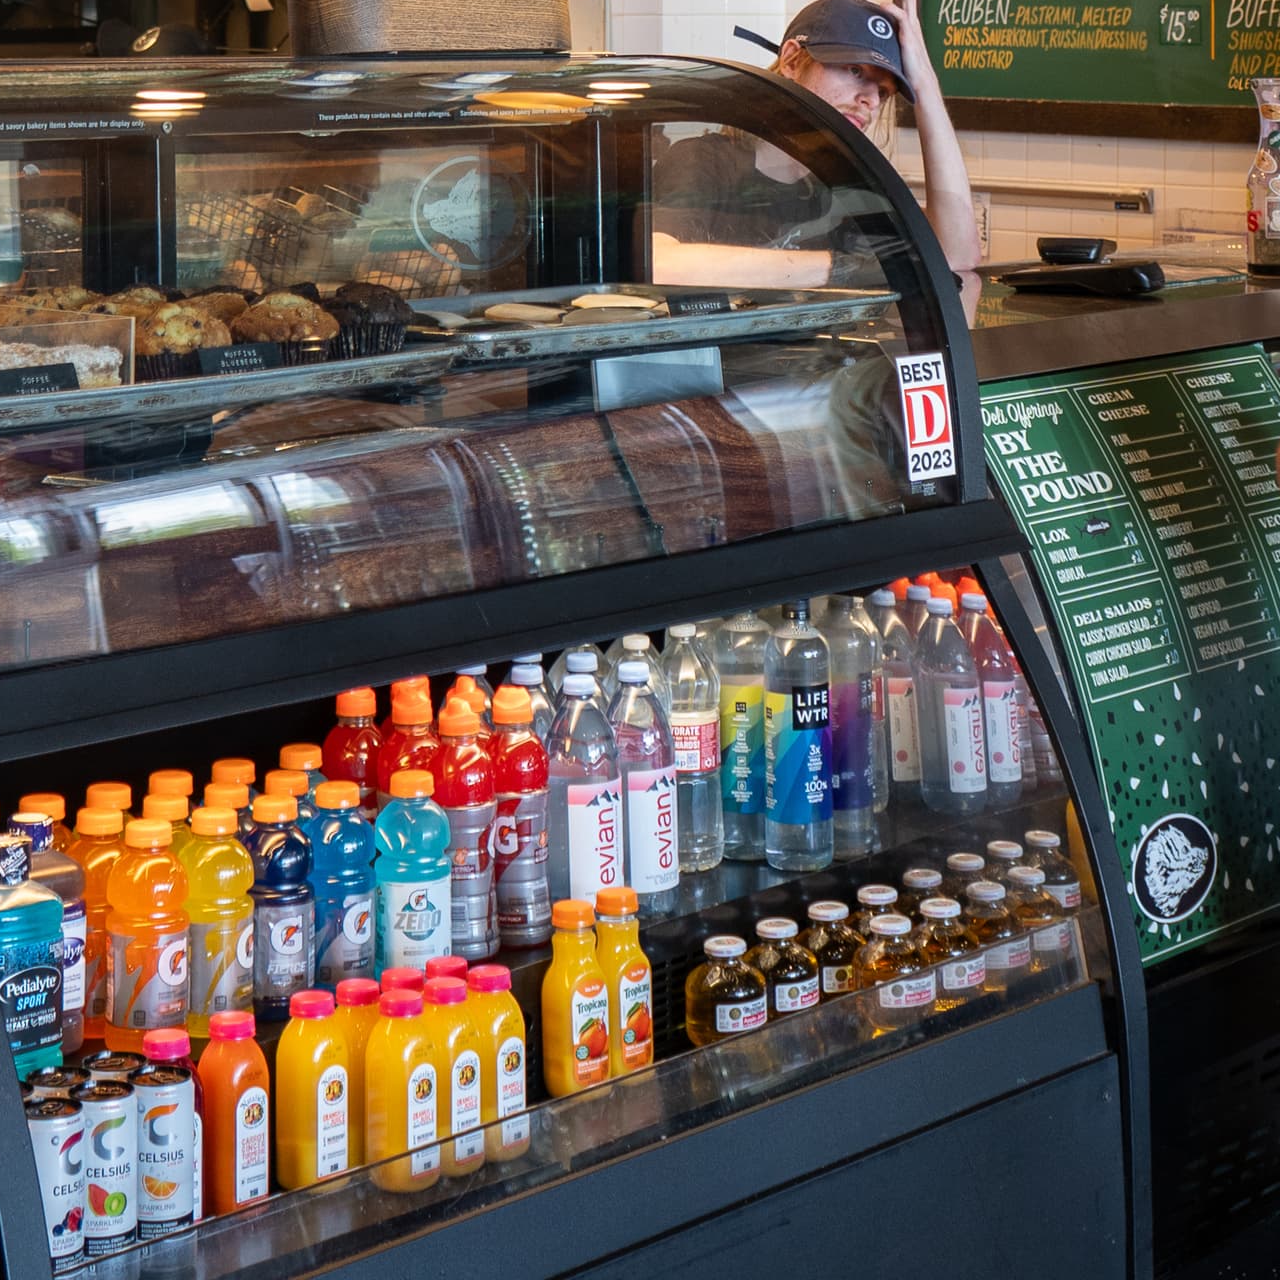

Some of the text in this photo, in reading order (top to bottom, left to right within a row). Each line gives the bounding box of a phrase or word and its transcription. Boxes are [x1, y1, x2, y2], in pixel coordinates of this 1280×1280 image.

[6, 123, 25, 132] savory
[27, 122, 47, 131] bakery
[110, 120, 130, 128] display
[900, 361, 941, 384] BEST
[1186, 372, 1235, 389] CHEESE
[1088, 388, 1134, 406] CREAM
[906, 390, 946, 445] D
[981, 400, 1063, 429] Deli Offerings
[1098, 403, 1150, 422] CHEESE
[992, 429, 1032, 456] BY
[911, 449, 952, 473] 2023
[1007, 451, 1067, 480] THE
[1020, 471, 1113, 508] POUND
[1040, 527, 1070, 545] LOX
[1073, 597, 1153, 628] DELI SALADS
[797, 691, 828, 706] LIFE
[797, 708, 828, 724] WTR
[654, 792, 673, 869] evian
[595, 806, 616, 886] evian
[394, 911, 442, 930] ZERO
[6, 975, 57, 998] Pedialyte
[624, 984, 650, 998] Tropicana
[16, 991, 48, 1012] SPORT
[576, 997, 607, 1014] Tropicana
[139, 1149, 185, 1164] CELSIUS
[86, 1164, 131, 1179] CELSIUS
